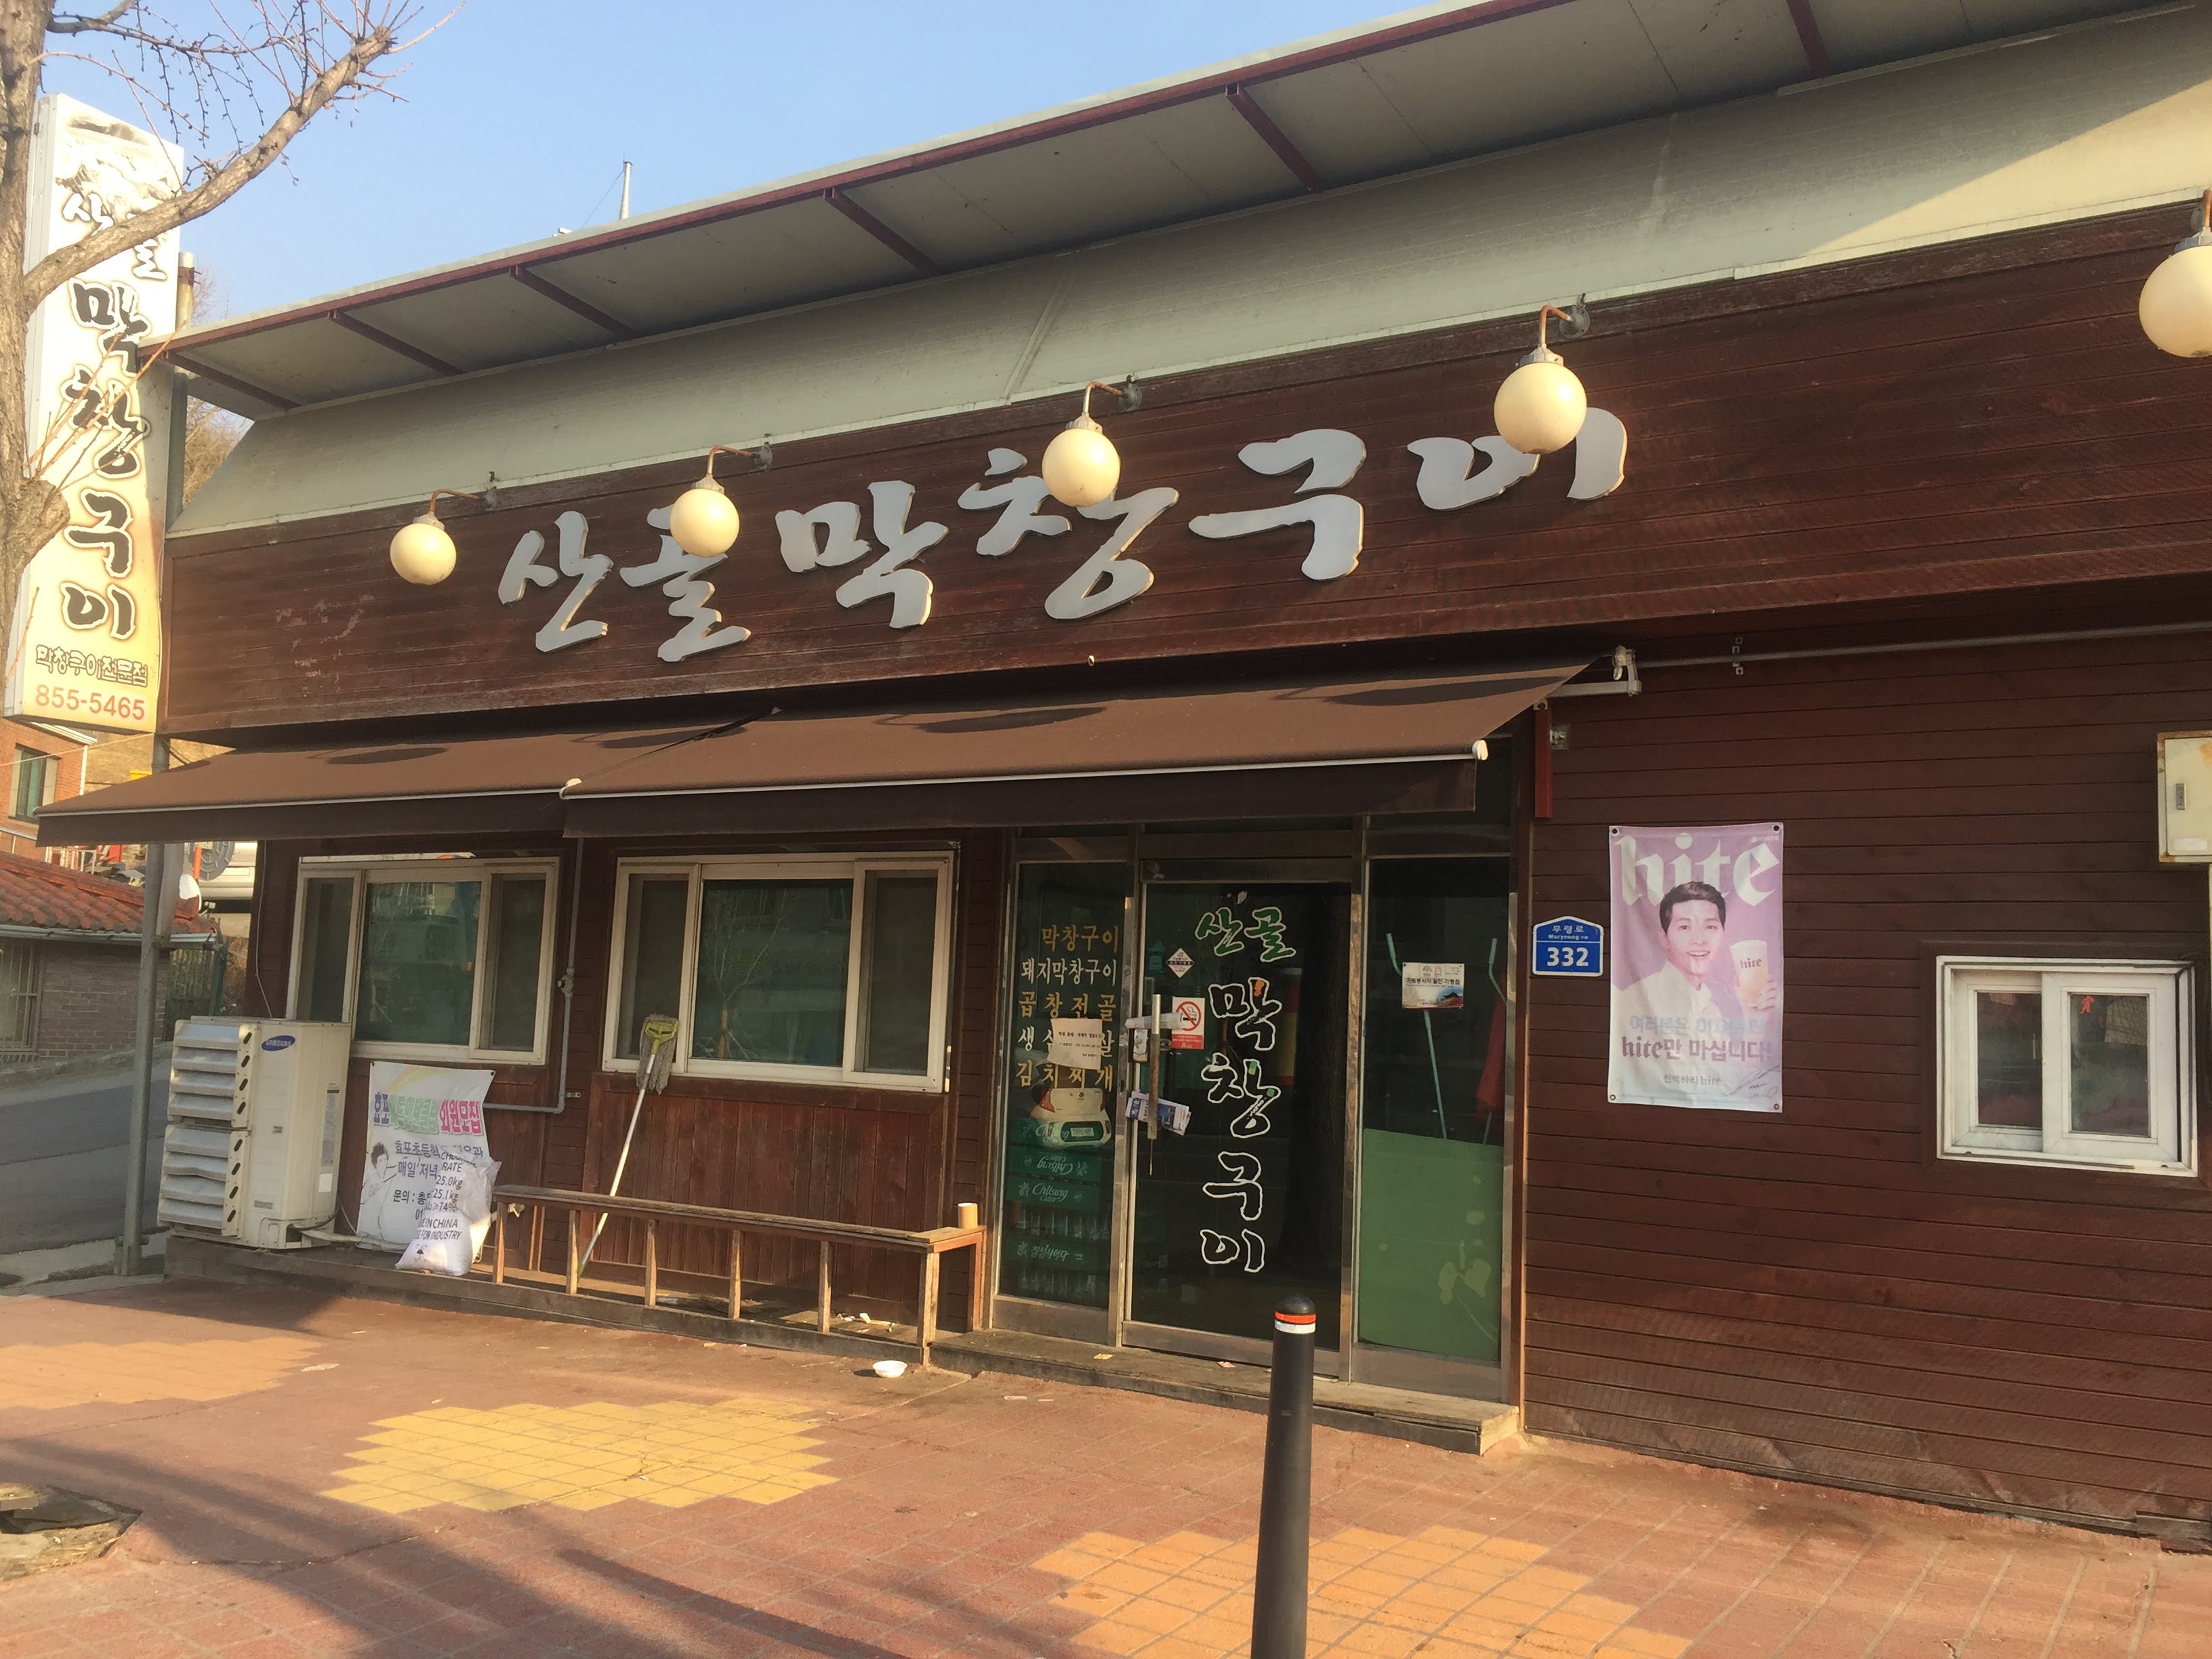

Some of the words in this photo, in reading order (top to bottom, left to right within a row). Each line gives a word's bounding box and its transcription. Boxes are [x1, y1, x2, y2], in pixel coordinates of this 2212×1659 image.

[36, 644, 148, 688] 막창구이전문점
[35, 684, 144, 720] 855-5465
[1615, 833, 1780, 907] hite
[1042, 924, 1118, 953] 막창구이
[1195, 907, 1296, 962] 산골
[1547, 947, 1589, 966] 332
[1740, 958, 1762, 968] hite
[1021, 958, 1117, 985] 돼지막창구이
[265, 1039, 292, 1048] SAMSUNG
[440, 1099, 482, 1134] 회원모집
[395, 1140, 449, 1159] 효포초등학
[398, 1161, 416, 1178] 매일
